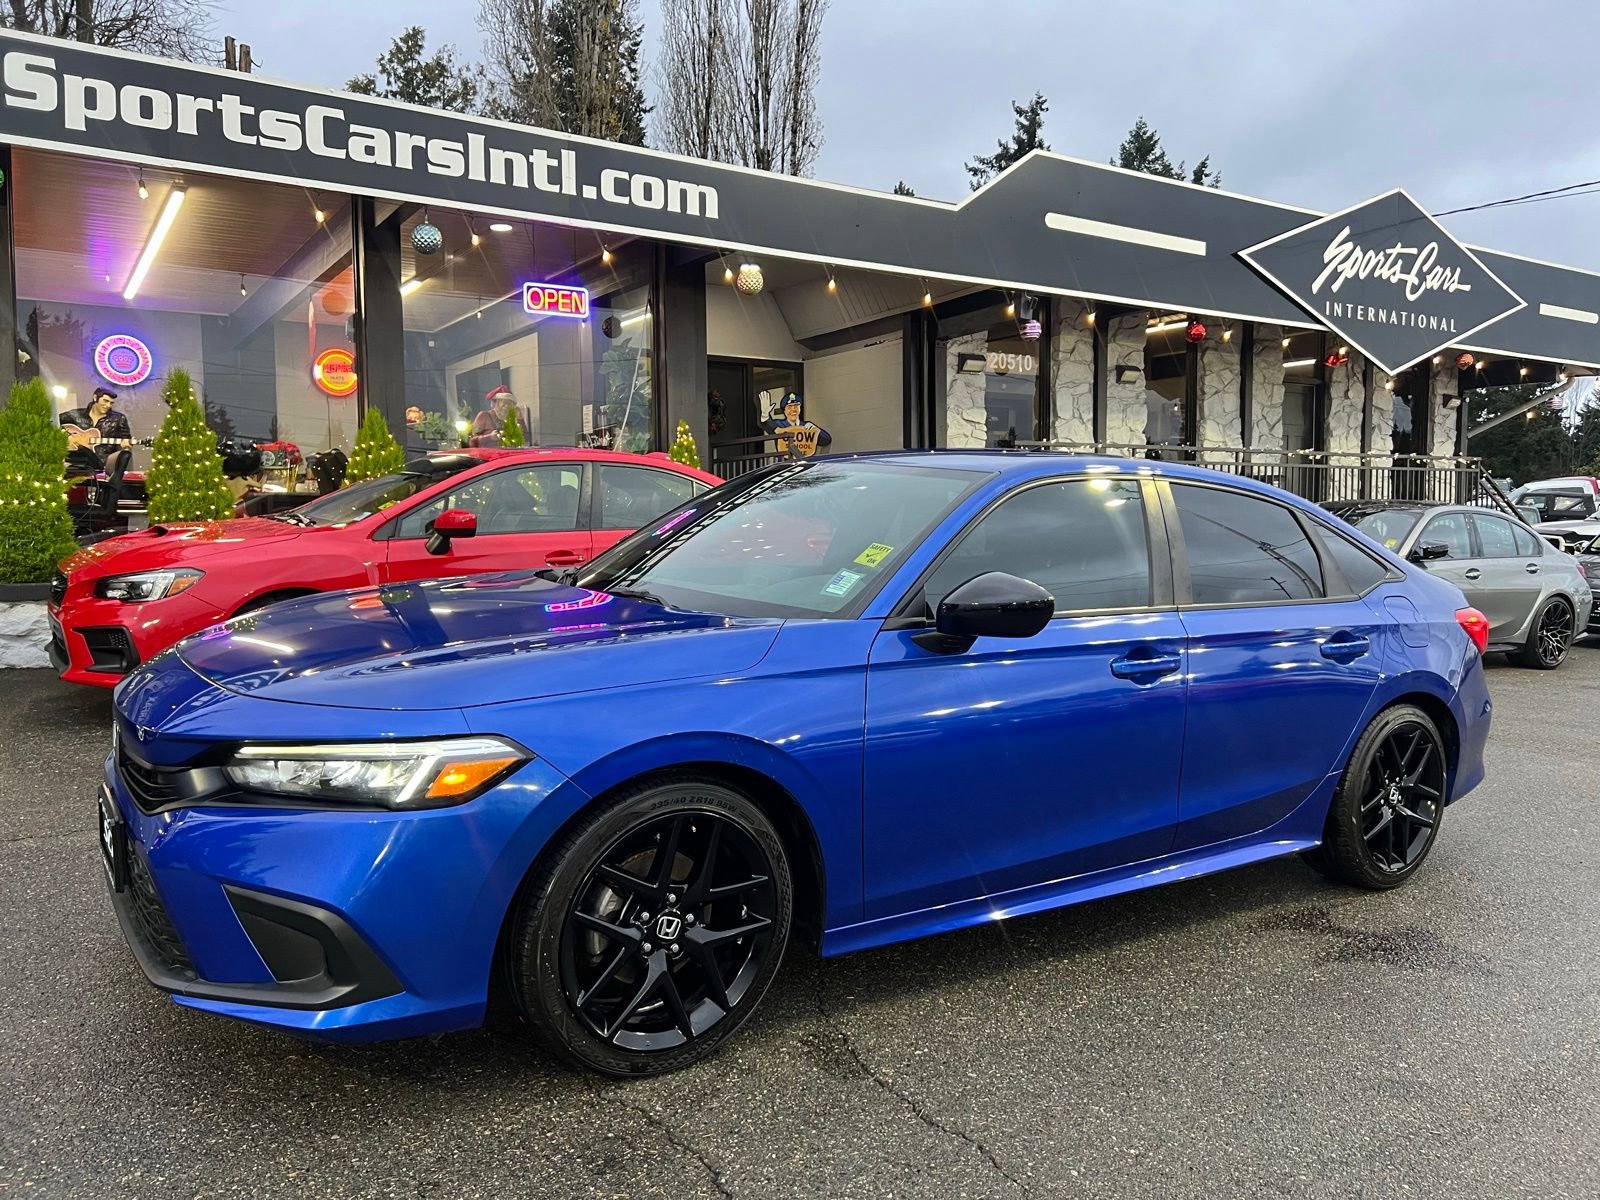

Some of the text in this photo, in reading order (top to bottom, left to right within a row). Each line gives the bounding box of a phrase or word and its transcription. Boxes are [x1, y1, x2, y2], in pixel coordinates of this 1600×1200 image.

[3, 51, 720, 220] SportsCarsIntl.com
[527, 287, 586, 314] OPEN
[1325, 301, 1457, 333] INTERNATIONAL
[990, 352, 1032, 372] 20510
[782, 431, 815, 443] OW
